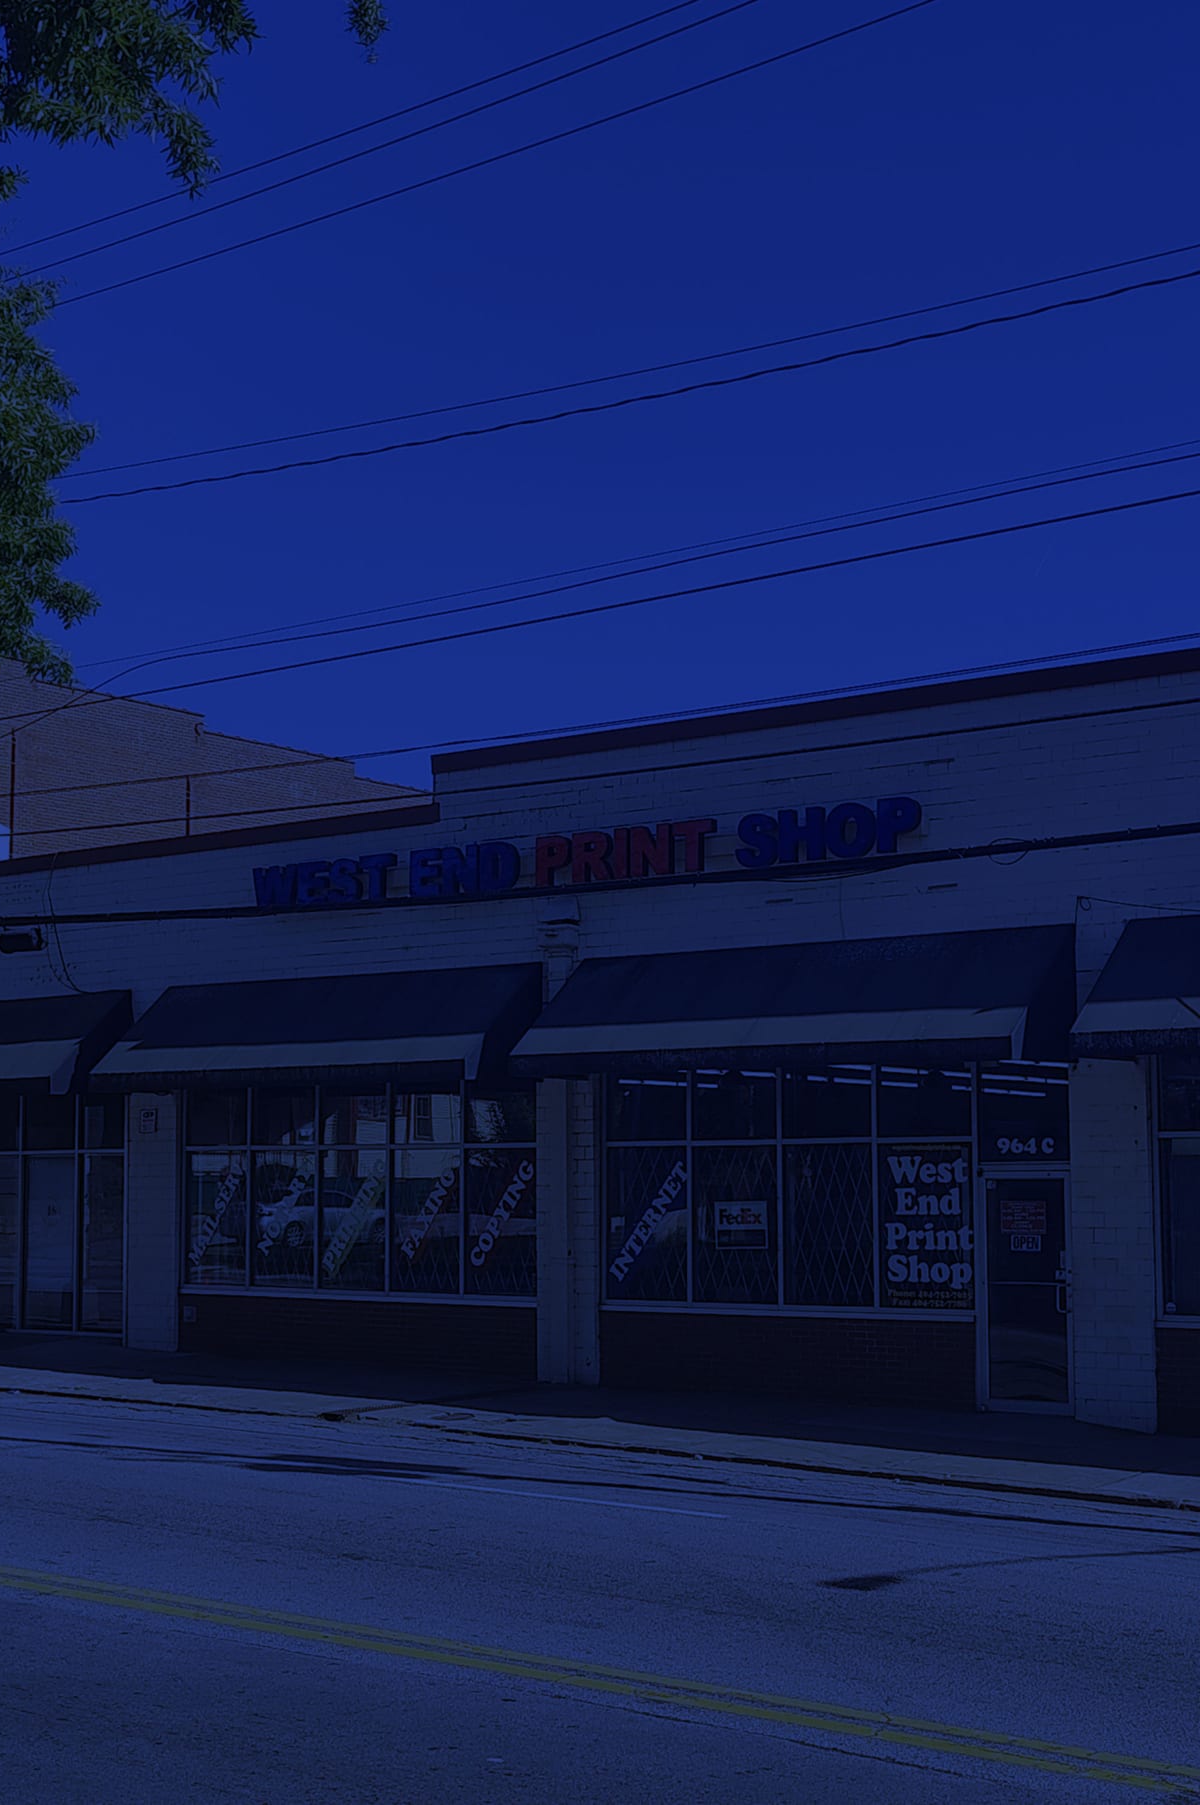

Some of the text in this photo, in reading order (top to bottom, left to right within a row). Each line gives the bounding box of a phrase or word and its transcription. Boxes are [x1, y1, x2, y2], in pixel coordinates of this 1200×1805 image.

[252, 797, 922, 909] WEST END PRINT SHOP
[996, 1136, 1056, 1155] 964 C
[887, 1155, 969, 1184] West
[257, 1160, 314, 1256] NOARY
[400, 1167, 457, 1260] FAXING
[470, 1158, 535, 1268] COPYING
[718, 1208, 762, 1225] FedEx
[894, 1187, 962, 1215] End
[188, 1212, 221, 1265] MAIL
[609, 1160, 688, 1283] INTERNET
[885, 1221, 974, 1250] Print
[1013, 1236, 1039, 1249] OPEN
[887, 1254, 973, 1289] Shop
